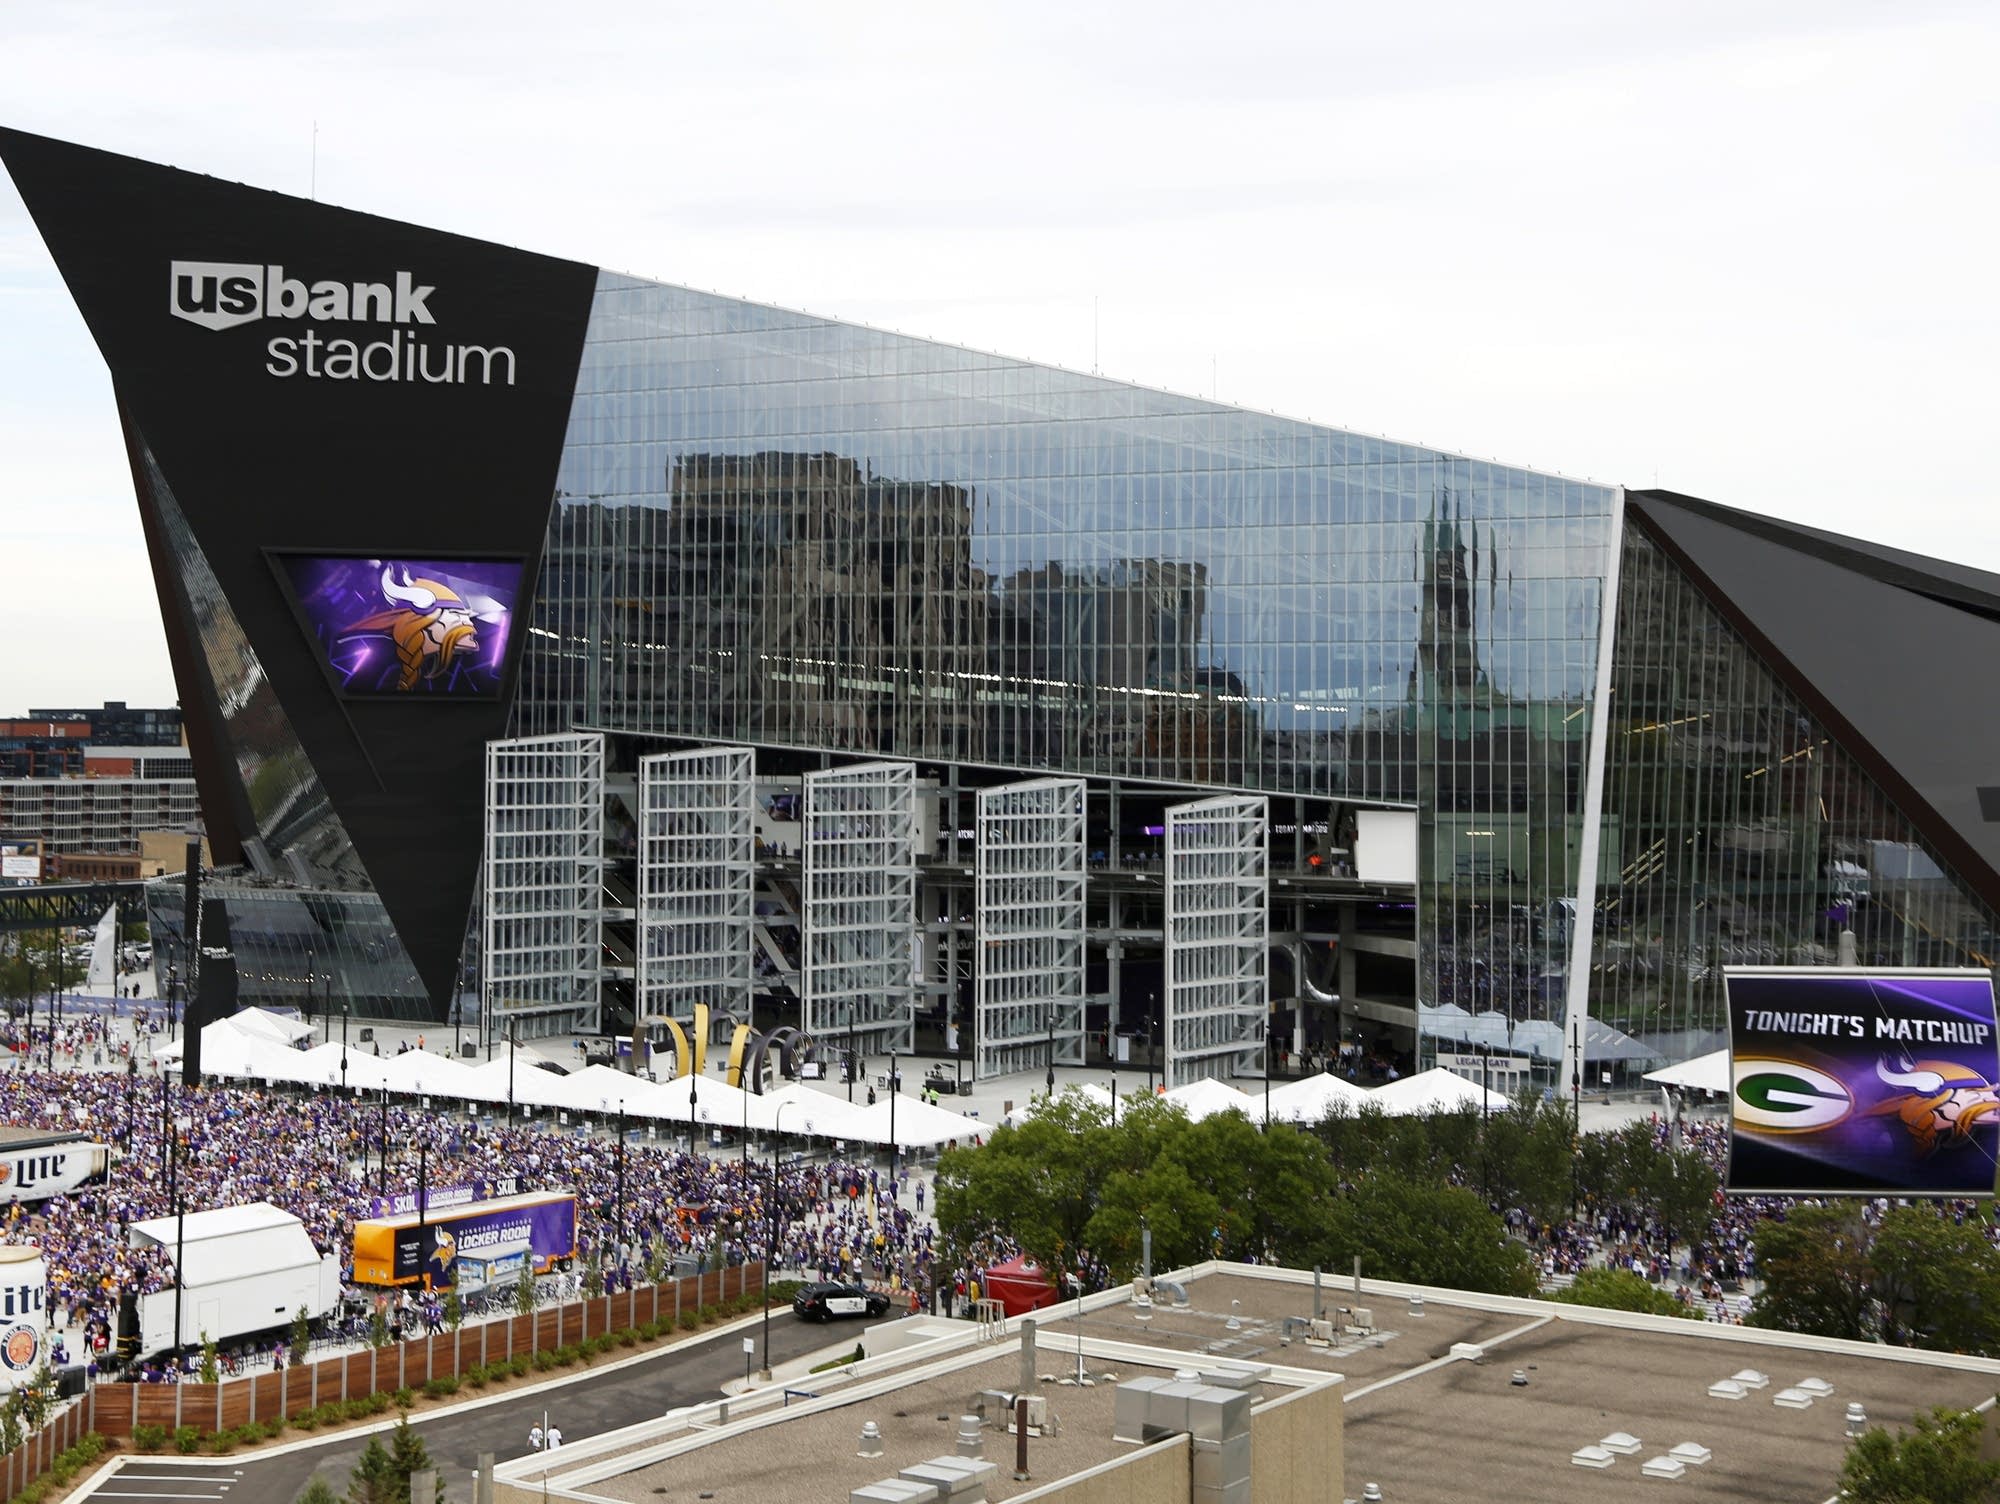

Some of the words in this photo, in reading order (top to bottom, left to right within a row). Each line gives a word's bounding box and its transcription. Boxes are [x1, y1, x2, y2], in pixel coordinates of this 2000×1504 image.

[265, 329, 516, 385] stadium
[1745, 1009, 1864, 1037] TONIGHT'S
[1875, 1019, 1989, 1045] MATCHUP
[1488, 1059, 1510, 1068] GATE
[496, 1178, 518, 1196] SKOL
[394, 1194, 417, 1214] SKOL
[458, 1230, 499, 1250] LOCKER
[500, 1224, 532, 1242] ROOM
